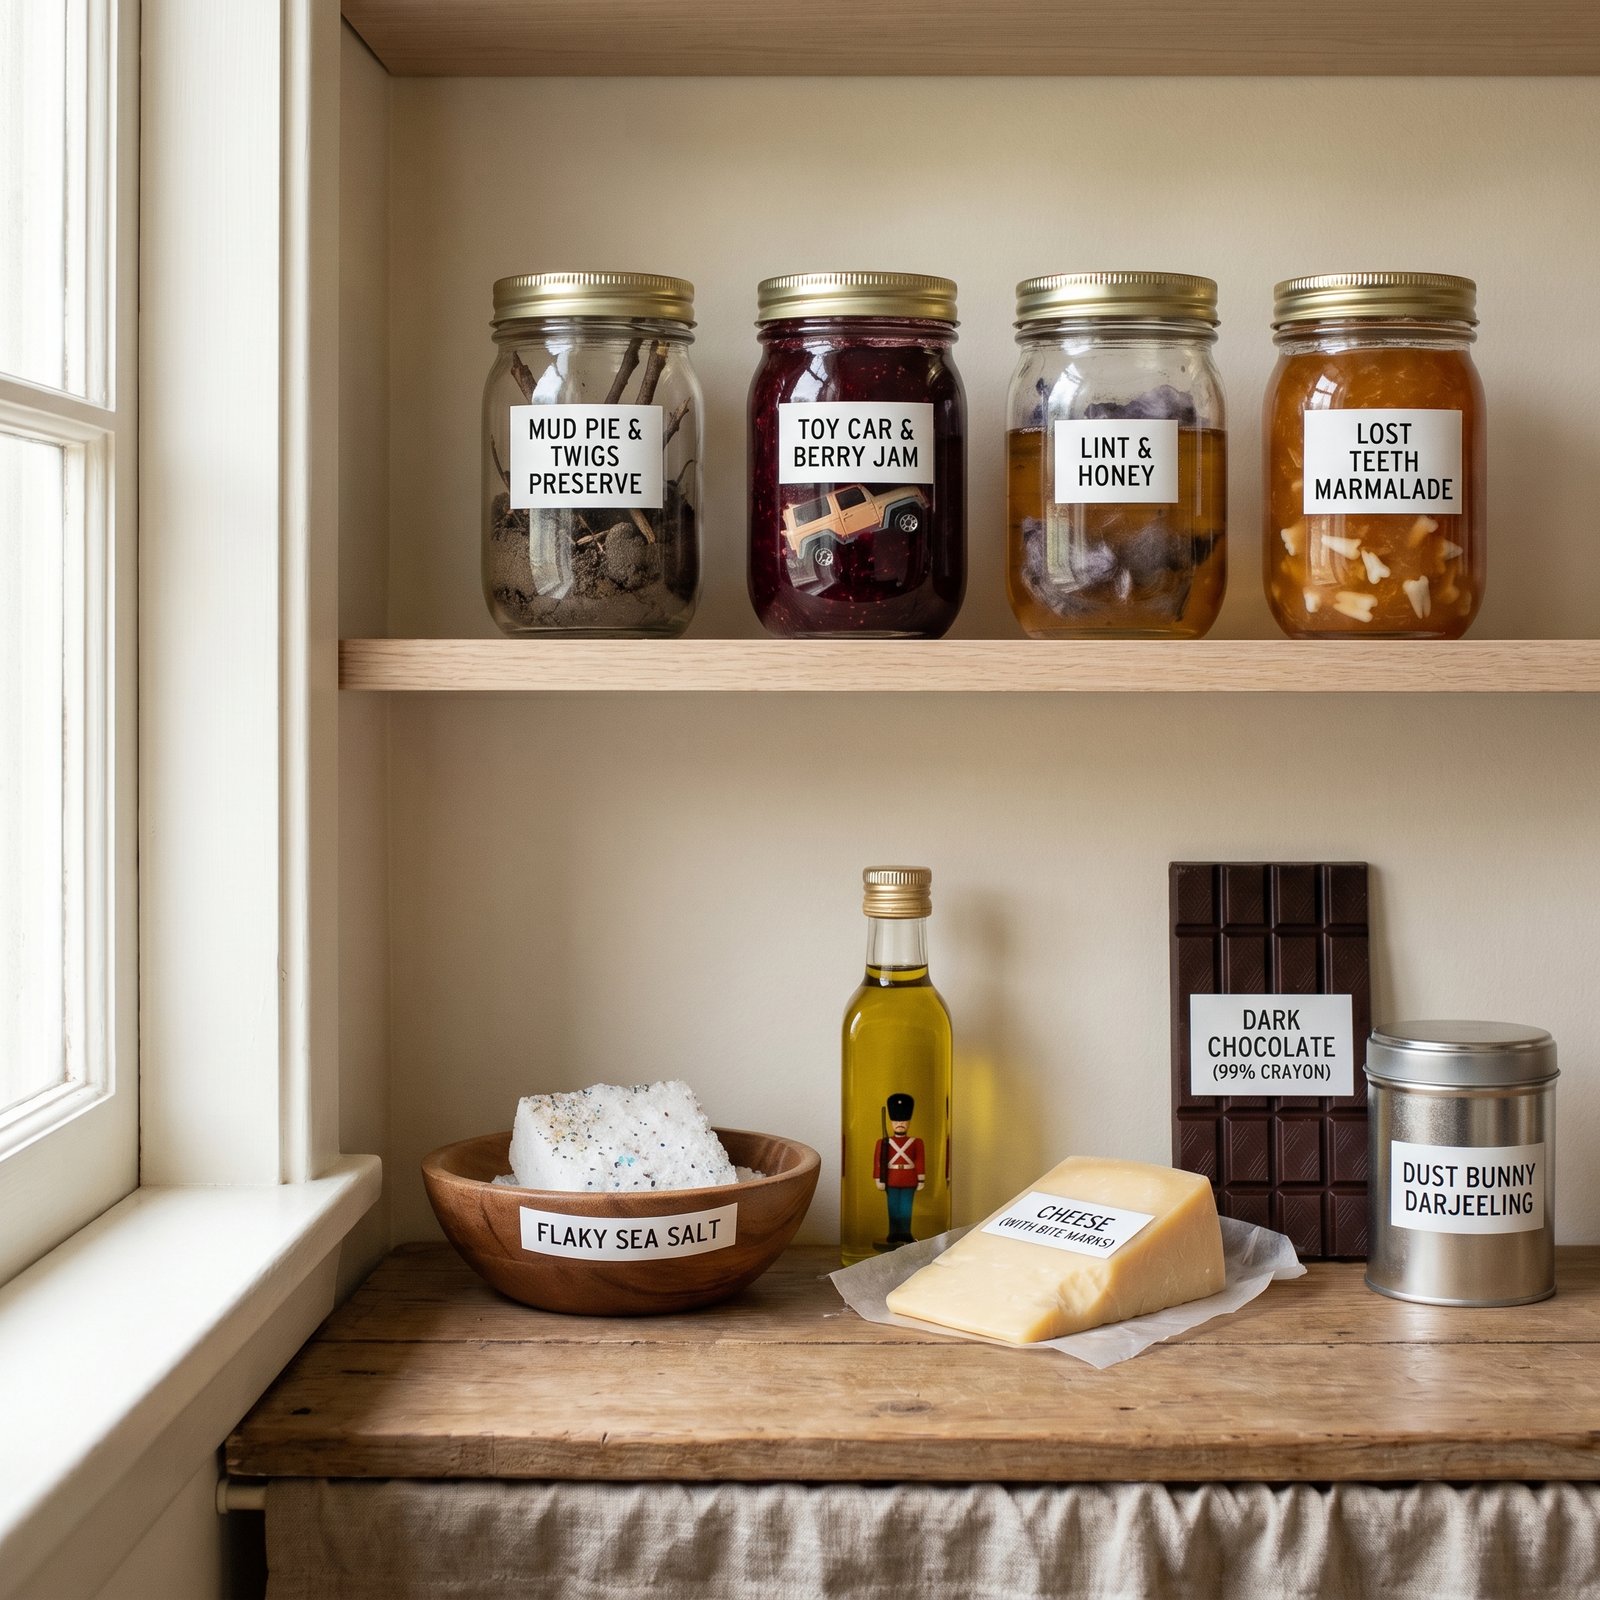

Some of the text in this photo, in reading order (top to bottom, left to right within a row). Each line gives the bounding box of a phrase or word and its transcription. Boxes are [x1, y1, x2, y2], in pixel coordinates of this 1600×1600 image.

[530, 418, 643, 440] MUD PIE &
[798, 418, 915, 440] TOY CAR &
[1357, 423, 1413, 445] LOST
[551, 445, 620, 467] TWIGS
[795, 446, 919, 468] BERRY JAM
[1081, 437, 1153, 459] LINT &
[1350, 451, 1419, 472] TEETH
[530, 473, 643, 495] PRESERVE
[1079, 465, 1155, 487] HONEY
[1315, 478, 1454, 500] MARMALADE
[1243, 1009, 1301, 1031] DARK
[1208, 1036, 1336, 1058] CHOCOLATE
[1212, 1063, 1331, 1081] (99% CRAYON)
[1403, 1161, 1536, 1188] DUST BUNNY
[1405, 1190, 1534, 1217] DARJEELING
[1036, 1205, 1116, 1232] CHEESE
[537, 1218, 722, 1250] FLAKY SEA SALT
[998, 1217, 1116, 1249] (WITH BITE MARKS)
